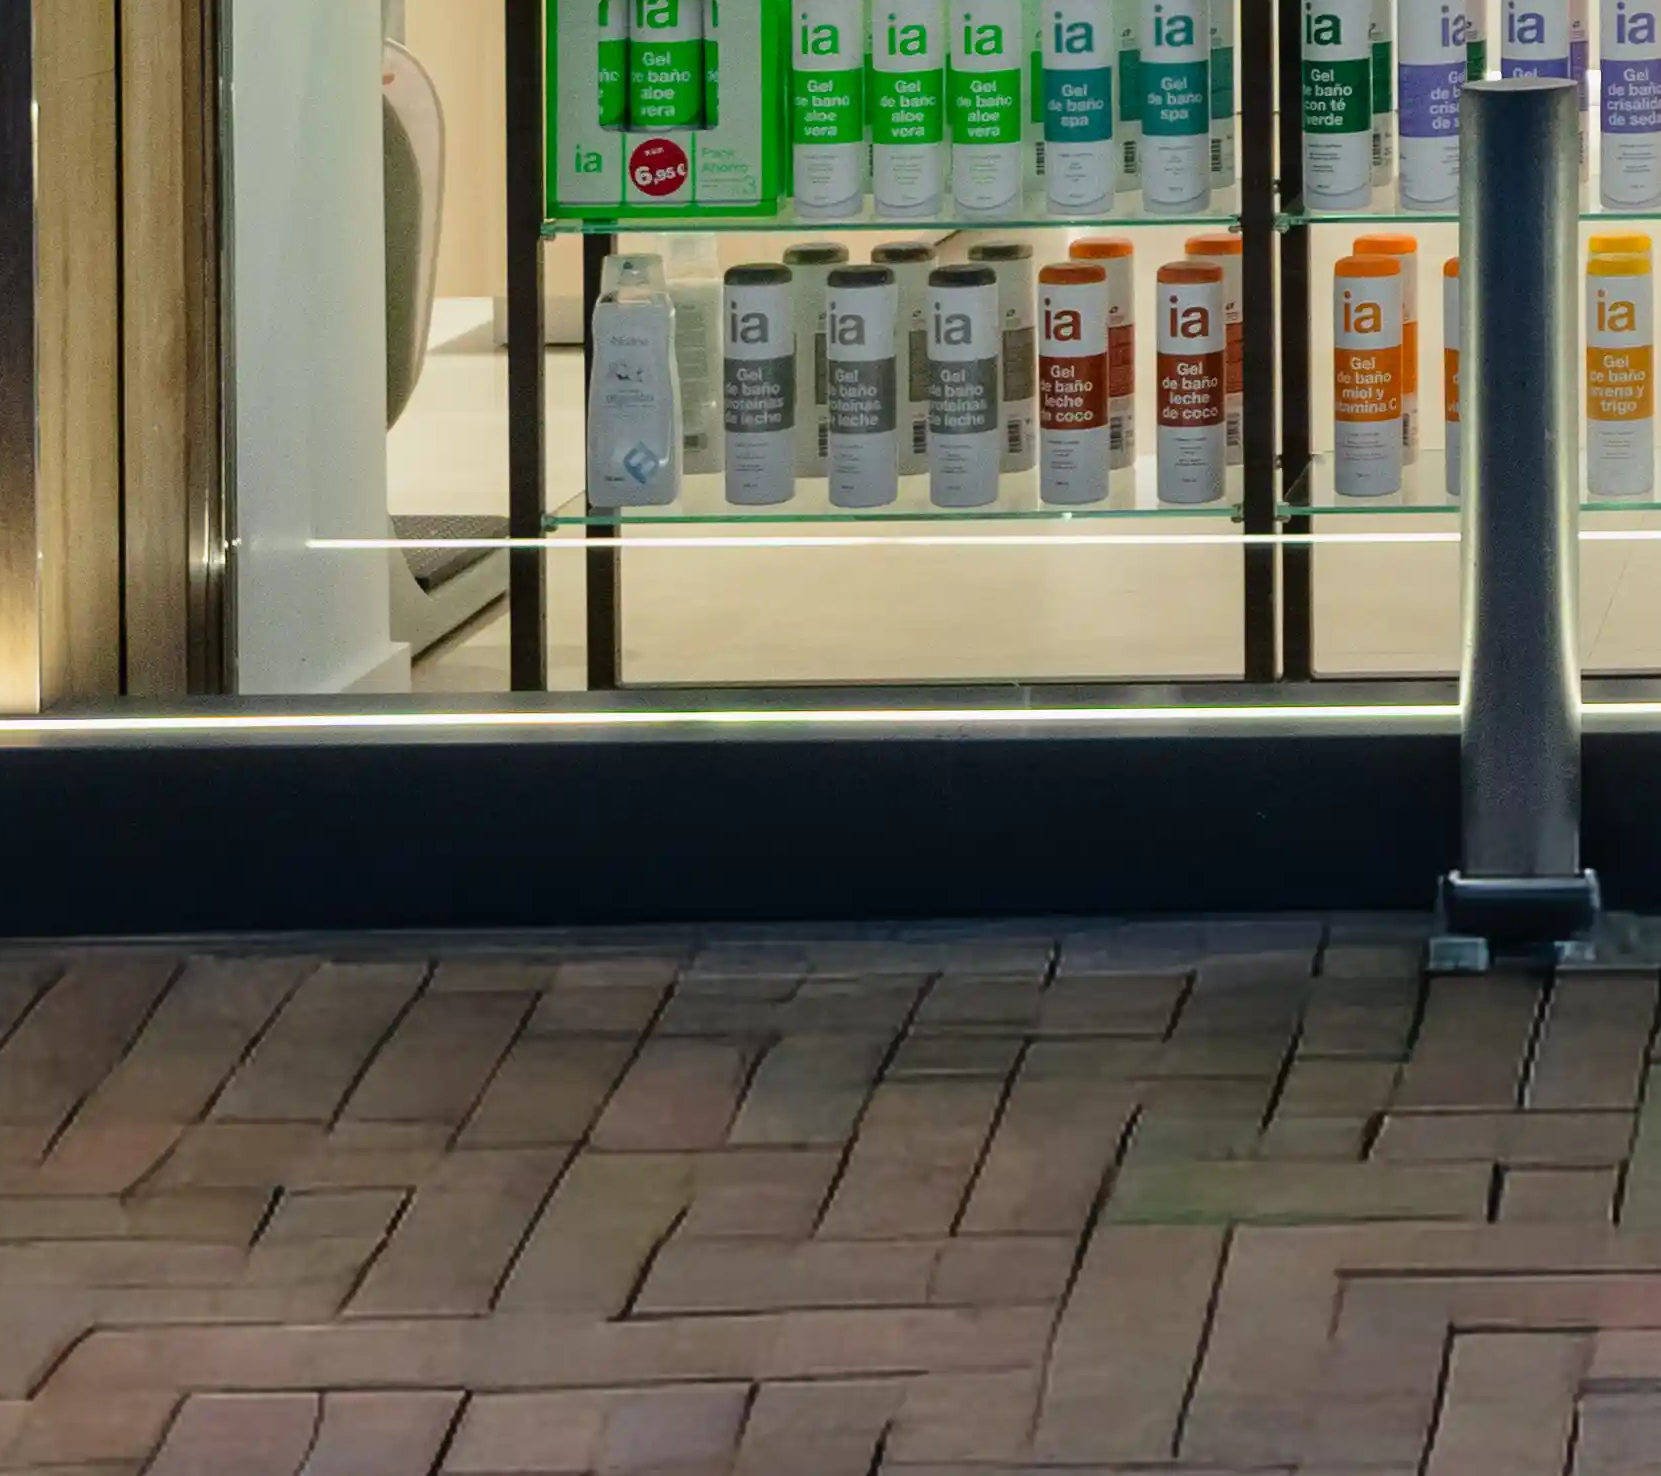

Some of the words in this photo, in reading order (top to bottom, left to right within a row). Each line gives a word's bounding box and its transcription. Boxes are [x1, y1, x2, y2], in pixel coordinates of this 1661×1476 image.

[1154, 4, 1194, 47] ia
[1305, 2, 1342, 46] ia
[1441, 5, 1467, 48] ia
[1507, 1, 1545, 44] ia
[1616, 1, 1656, 44] ia
[801, 13, 840, 55] ia
[887, 14, 928, 56] ia
[963, 13, 1004, 56] ia
[1054, 11, 1094, 54] ia
[642, 52, 671, 67] Gel
[648, 69, 690, 83] baño
[1311, 69, 1335, 82] Gel
[1512, 68, 1538, 79] Gel
[1623, 69, 1649, 82] Gel
[807, 80, 834, 93] Gel
[895, 80, 921, 93] Gel
[970, 80, 997, 93] Gel
[1061, 83, 1088, 98] Gel
[1160, 77, 1188, 91] Gel
[1315, 82, 1353, 97] baño
[1608, 84, 1625, 96] de
[640, 87, 675, 100] aloe
[1431, 87, 1450, 100] de
[812, 95, 850, 108] baño
[975, 94, 1012, 108] baño
[1304, 100, 1327, 111] con
[1329, 98, 1346, 111] té
[804, 111, 837, 122] aloe
[891, 111, 925, 123] aloe
[967, 111, 1000, 123] aloe
[1060, 114, 1089, 128] spa
[1160, 107, 1189, 122] spa
[1306, 112, 1344, 126] verde
[1608, 113, 1626, 126] de
[1432, 116, 1451, 129] de
[804, 125, 838, 137] vera
[891, 125, 925, 137] vera
[967, 125, 1001, 138] vera
[575, 144, 603, 174] ia
[1169, 295, 1209, 338] ia
[1343, 291, 1381, 334] ia
[1596, 290, 1637, 333] ia
[730, 301, 769, 344] ia
[829, 301, 866, 345] ia
[934, 302, 972, 345] ia
[1044, 298, 1082, 341] ia
[1177, 362, 1203, 376] Gel
[1351, 357, 1376, 370] Gel
[1603, 355, 1629, 369] Gel
[737, 368, 763, 382] Gel
[836, 368, 859, 383] Gel
[940, 369, 966, 383] Gel
[1050, 364, 1075, 379] Gel
[1355, 371, 1391, 384] baño
[1608, 370, 1646, 382] baño
[742, 383, 780, 396] baño
[1055, 379, 1093, 392] baño
[1162, 378, 1178, 389] de
[1181, 376, 1218, 389] baño
[840, 383, 877, 397] baño
[945, 384, 984, 397] baño
[1376, 389, 1384, 400] y
[1045, 394, 1084, 408] leche
[1169, 391, 1211, 405] leche
[1388, 399, 1397, 411] C
[1162, 407, 1178, 419] de
[1181, 406, 1218, 419] coco
[1600, 399, 1637, 414] trigo
[741, 412, 782, 425] leche
[839, 412, 880, 427] leche
[943, 412, 985, 426] leche
[1055, 410, 1093, 422] coco
